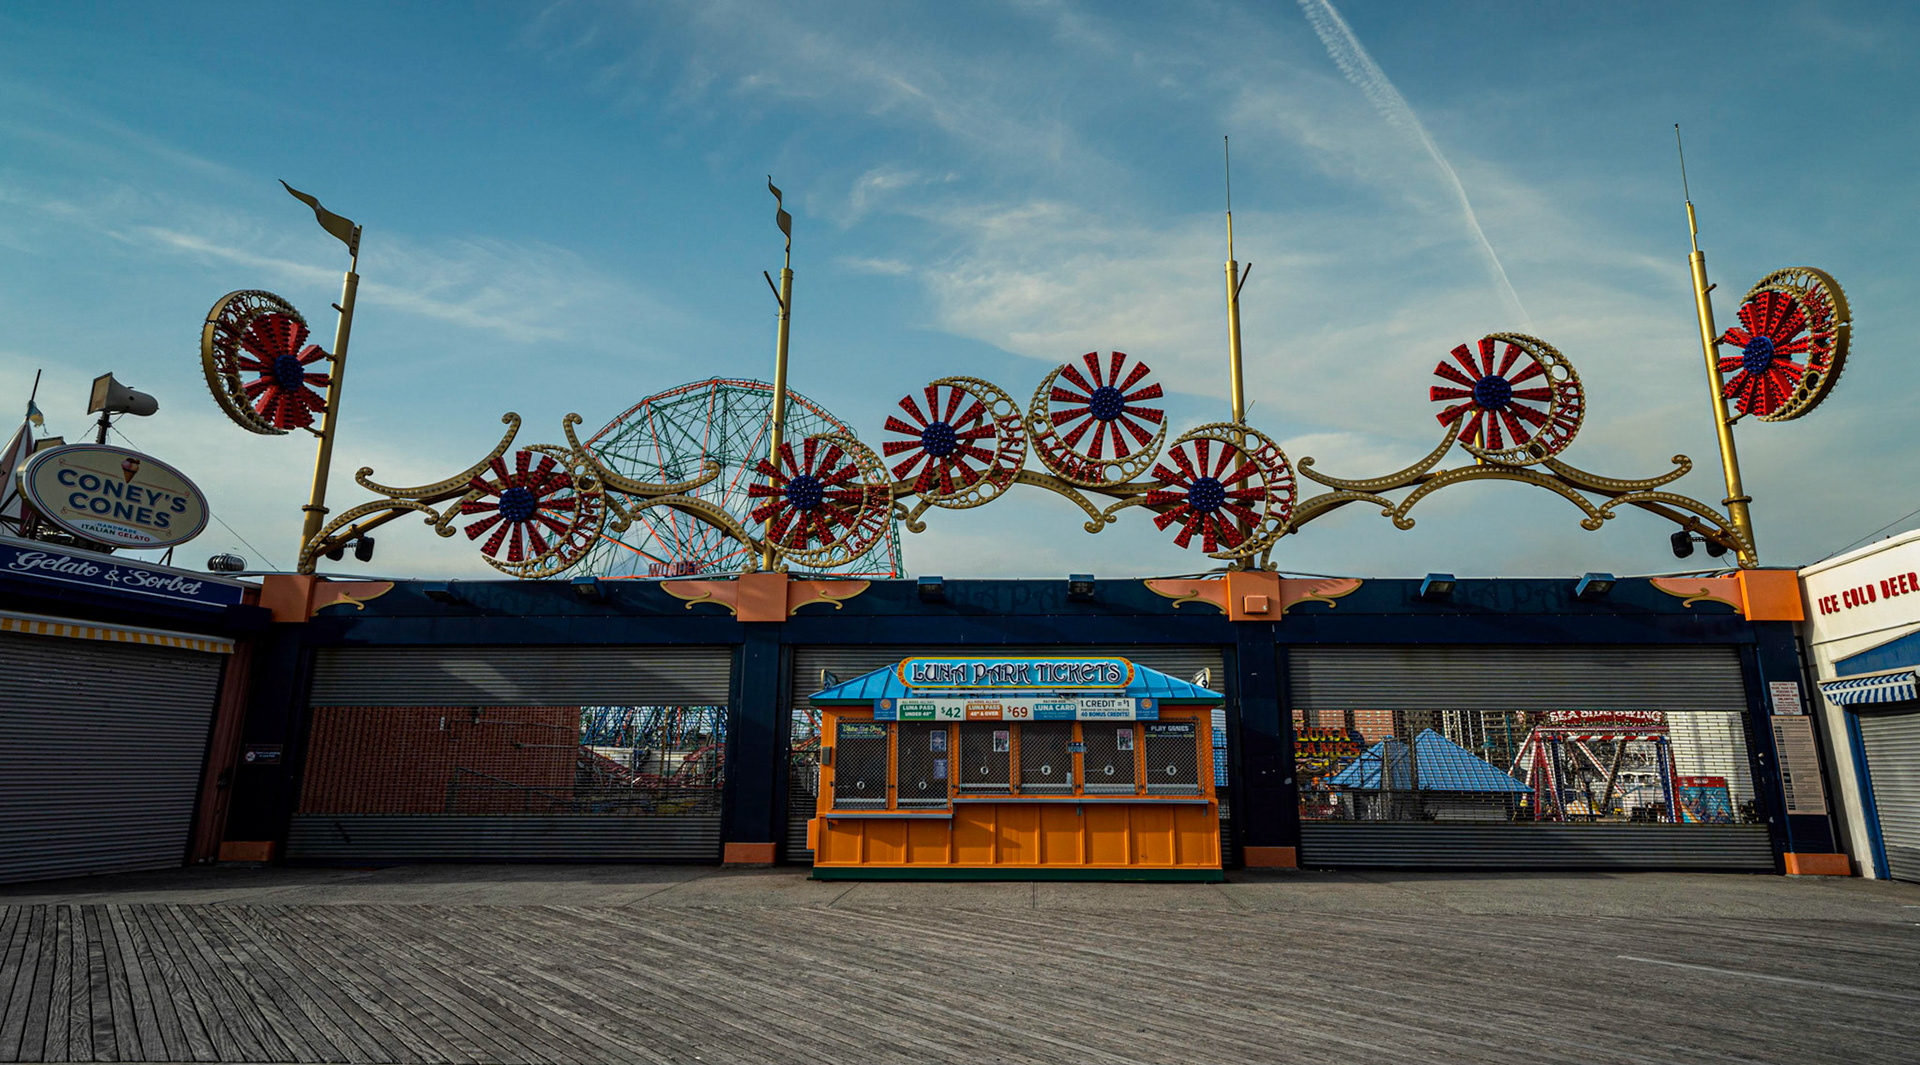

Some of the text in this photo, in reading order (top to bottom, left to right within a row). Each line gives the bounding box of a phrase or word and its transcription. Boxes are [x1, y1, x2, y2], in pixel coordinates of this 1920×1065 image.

[57, 468, 188, 514] CONEY'S
[68, 491, 172, 529] CONES
[81, 523, 151, 542] ITALIAN GELATO
[96, 521, 138, 534] HANDMADE
[8, 551, 203, 596] Gelato & Sorbet
[648, 561, 703, 577] WONDER
[1818, 571, 1920, 616] ICE COLD BEER
[911, 661, 1122, 686] LUNA PARK TICKETS
[940, 706, 961, 718] $42
[1007, 705, 1028, 718] $69
[1150, 724, 1167, 732] PLAY
